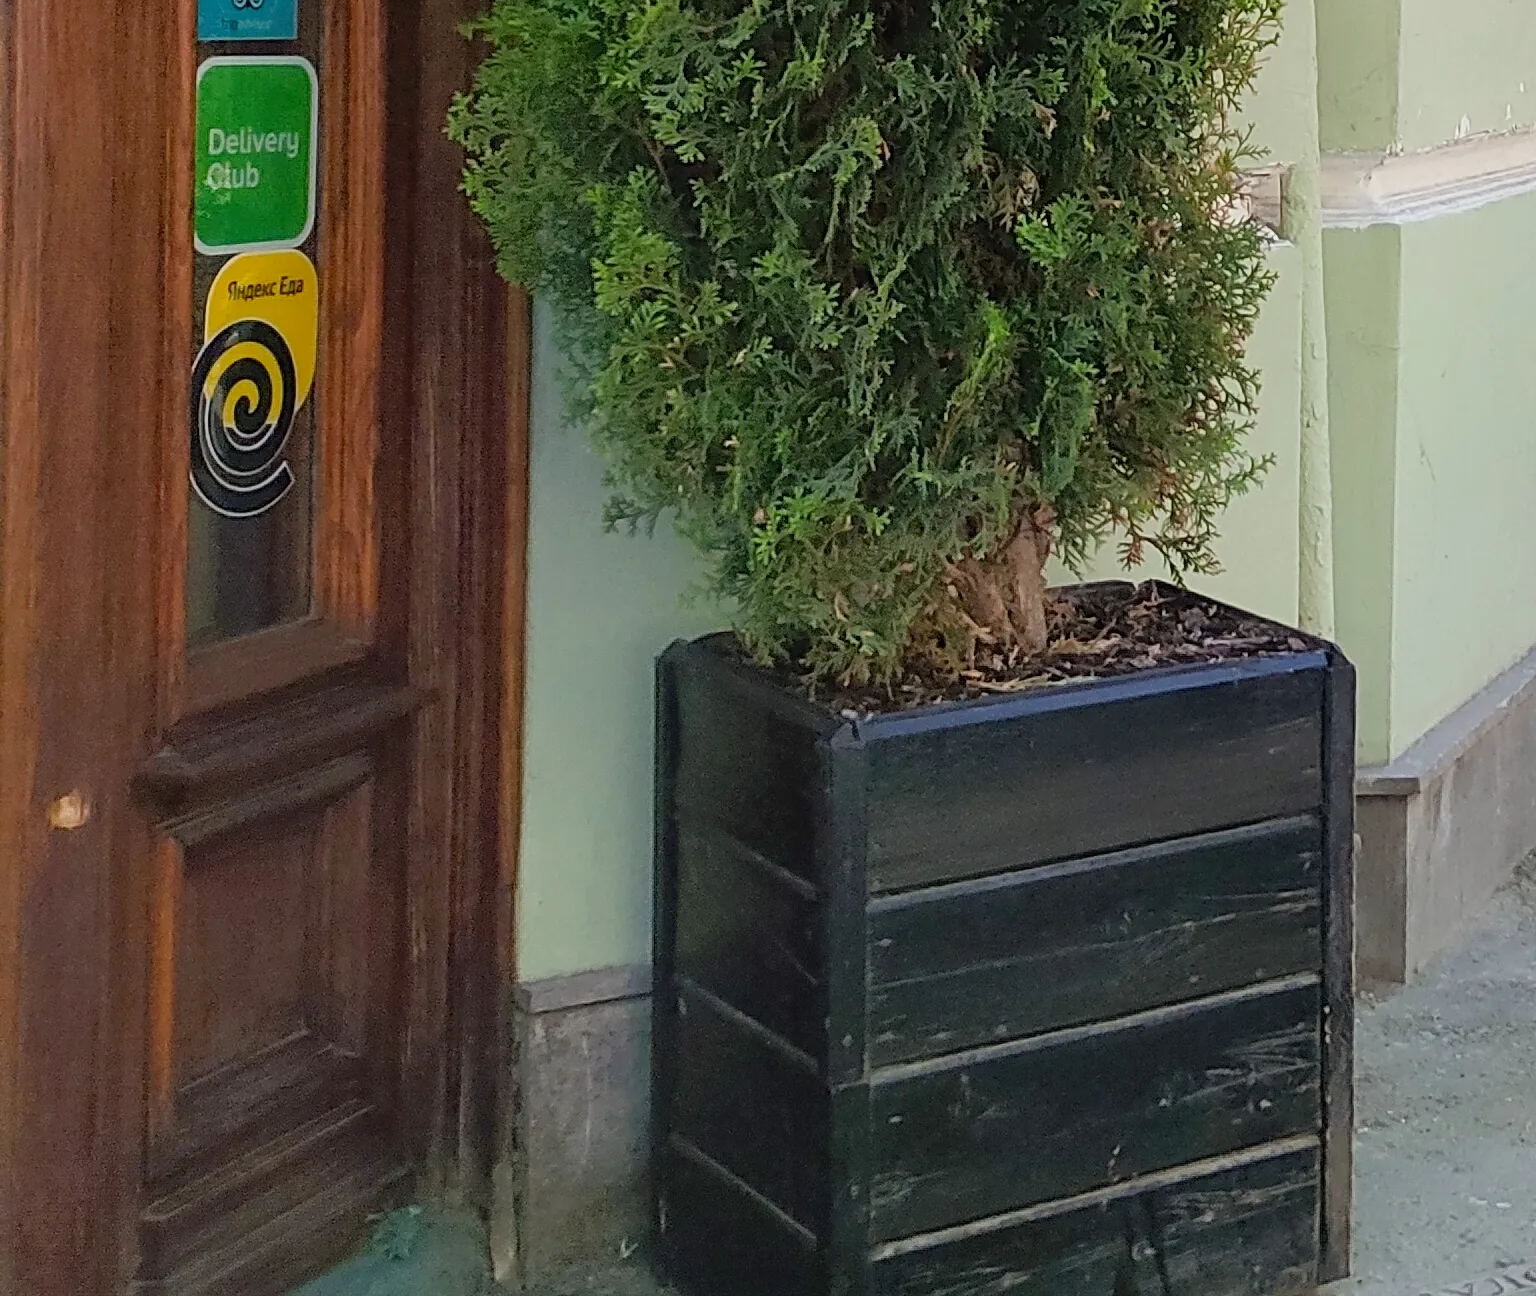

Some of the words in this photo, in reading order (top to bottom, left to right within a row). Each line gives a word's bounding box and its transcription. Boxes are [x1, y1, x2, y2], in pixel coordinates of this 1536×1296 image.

[208, 126, 300, 159] Delivery
[206, 160, 260, 191] Club
[227, 280, 277, 302] Яндекс
[279, 275, 304, 297] Еда
